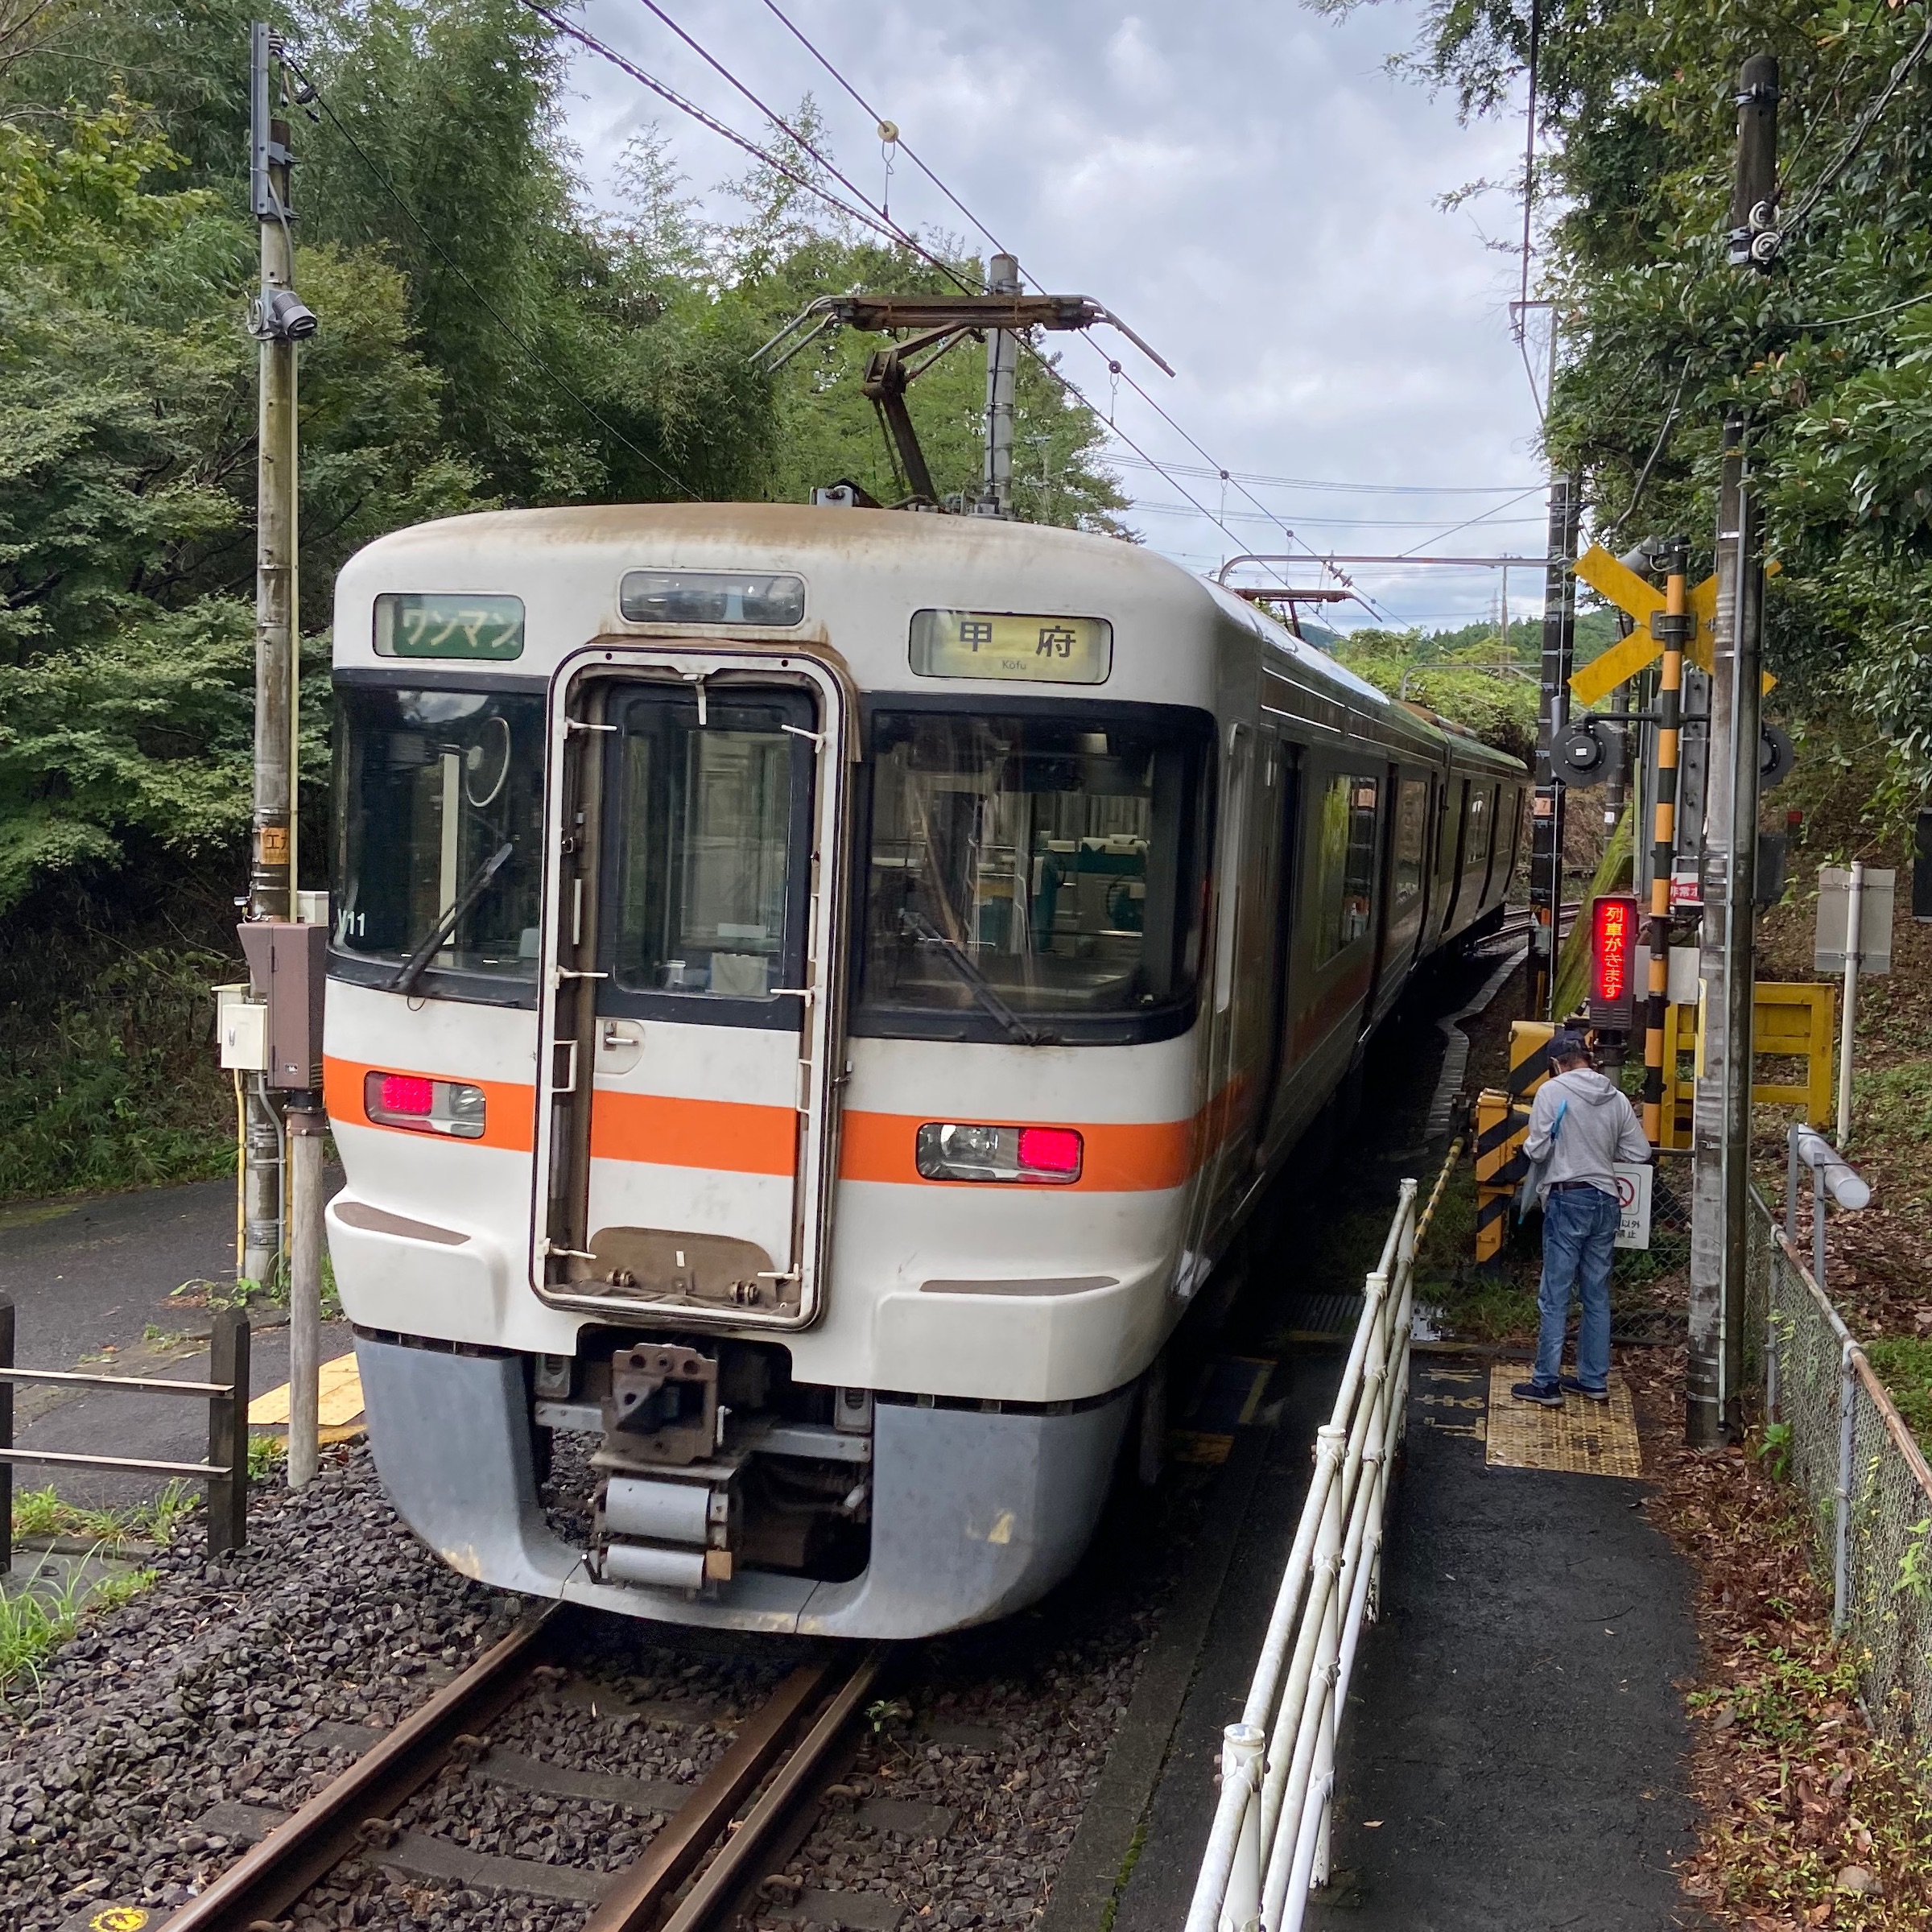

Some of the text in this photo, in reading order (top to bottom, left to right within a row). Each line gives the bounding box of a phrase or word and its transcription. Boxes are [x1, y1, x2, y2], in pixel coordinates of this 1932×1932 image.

[403, 609, 522, 648] ワンマン
[960, 621, 1077, 658] 甲府
[1603, 906, 1624, 998] 列車がきます
